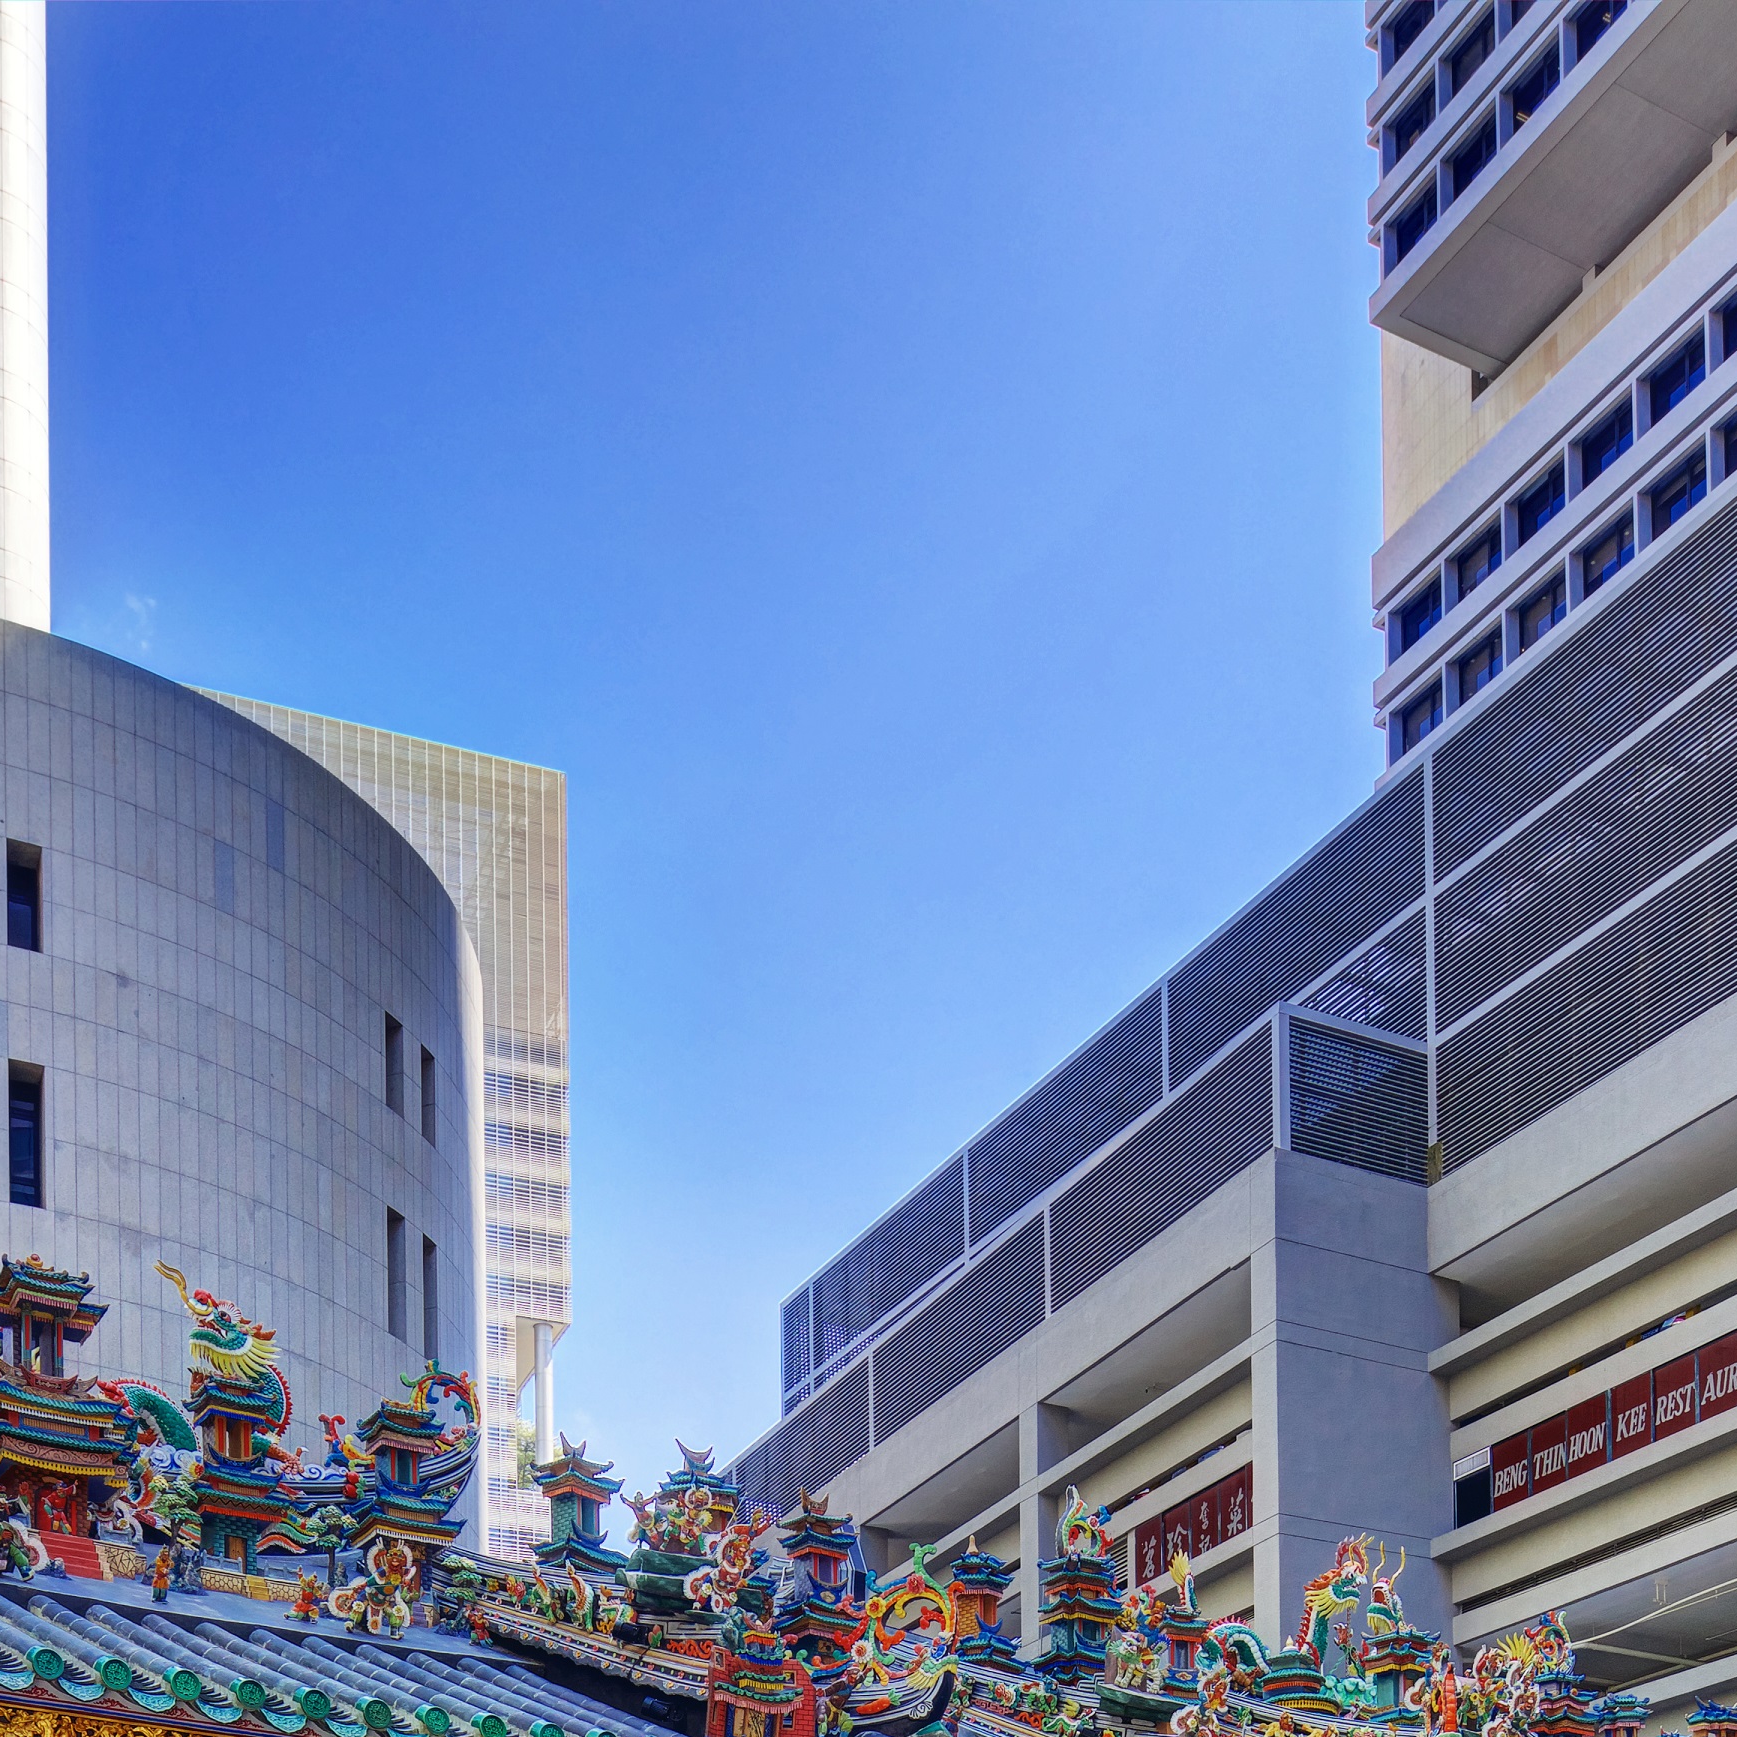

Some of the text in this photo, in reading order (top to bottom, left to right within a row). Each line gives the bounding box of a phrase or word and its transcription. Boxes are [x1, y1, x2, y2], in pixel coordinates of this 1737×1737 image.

[1494, 1459, 1528, 1498] BENG
[1533, 1441, 1567, 1480] THIN
[1568, 1422, 1606, 1464] HOON
[1615, 1402, 1648, 1443] KEE
